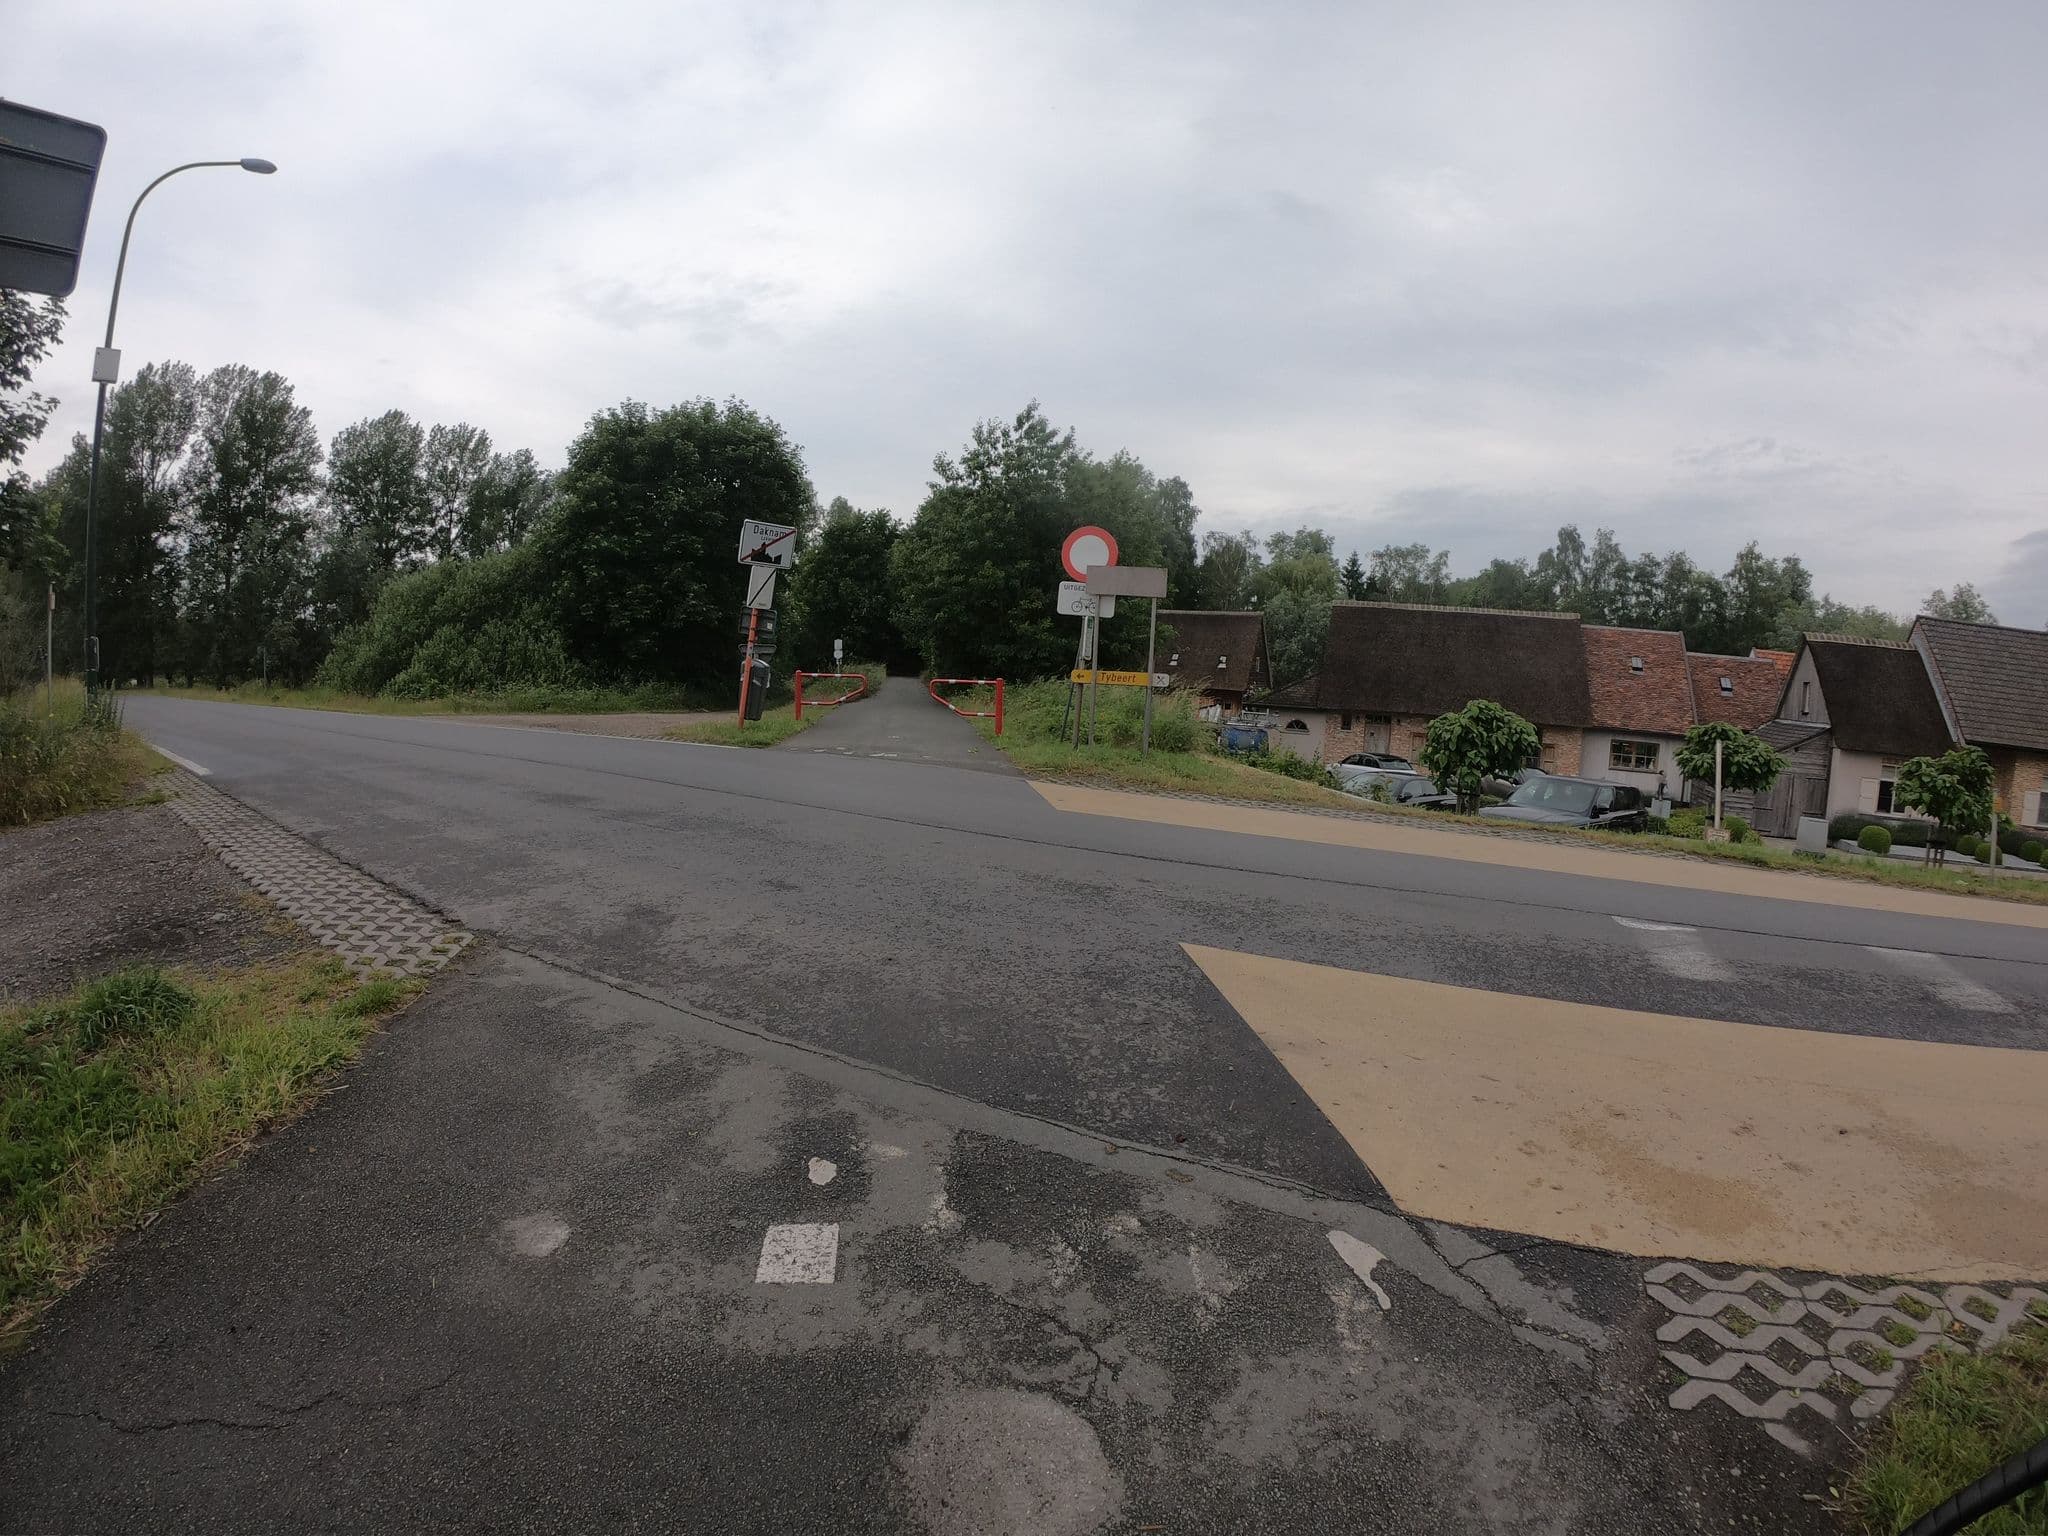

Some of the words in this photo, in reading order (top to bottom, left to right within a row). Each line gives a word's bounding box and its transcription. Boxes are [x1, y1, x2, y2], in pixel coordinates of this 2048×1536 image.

[753, 525, 787, 538] Daknam
[1063, 584, 1086, 592] UITGEZ
[1101, 672, 1137, 683] Tybeert
